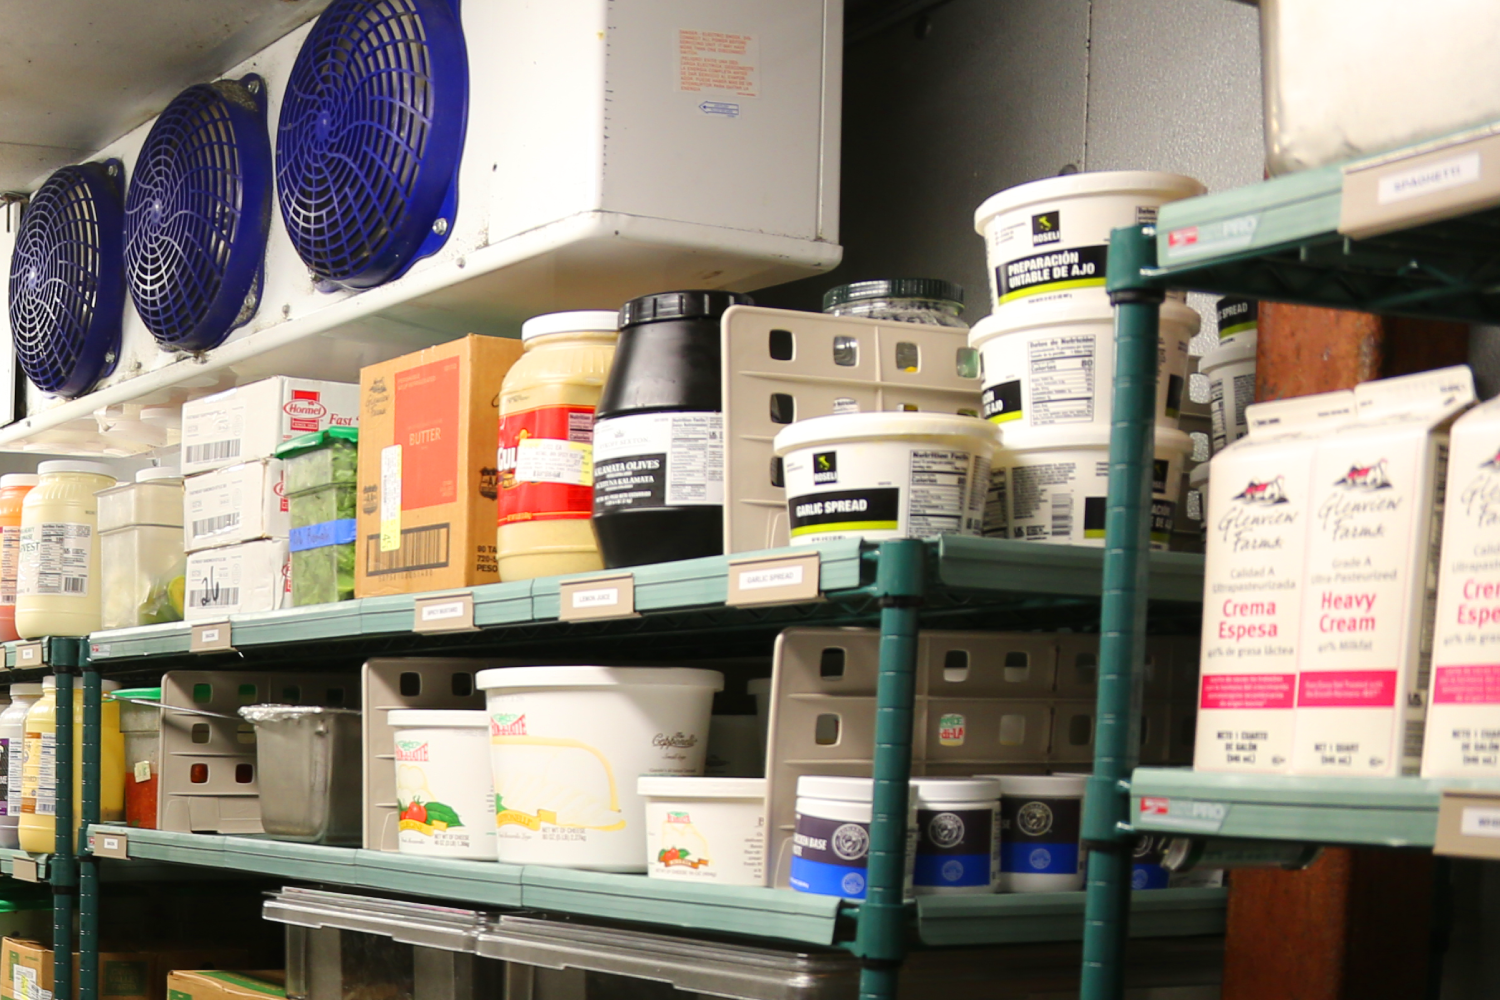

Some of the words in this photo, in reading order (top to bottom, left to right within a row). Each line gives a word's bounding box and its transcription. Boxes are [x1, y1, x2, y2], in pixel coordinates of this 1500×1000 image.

[1033, 231, 1060, 243] ROSELI
[1008, 251, 1079, 276] PREPARACIÓN
[1009, 270, 1050, 289] UNTABLE
[1052, 266, 1069, 279] DE
[1071, 262, 1095, 276] AJO
[1221, 303, 1248, 319] SPREAD
[289, 403, 322, 415] Hormel
[329, 413, 352, 426] Fast
[409, 427, 441, 446] BUTTER
[497, 447, 518, 472] GUL
[626, 459, 660, 470] OLIVES
[814, 472, 837, 482] ROSELI
[796, 502, 822, 518] GARLIC
[824, 499, 868, 514] SPREAD
[1318, 493, 1401, 530] Glenview
[1218, 507, 1297, 543] Glenview
[1333, 514, 1384, 541] Farms
[488, 545, 498, 553] TA
[1234, 528, 1282, 552] Farms
[1332, 558, 1360, 568] Grade
[1364, 557, 1372, 566] A
[771, 571, 794, 582] SPREAD
[1231, 567, 1265, 578] Calidad
[1268, 567, 1275, 575] A
[579, 594, 597, 603] LEMON
[1321, 591, 1376, 613] Heavy
[1223, 599, 1276, 617] Crema
[1457, 604, 1500, 629] Espe
[1219, 621, 1278, 642] Espesa
[1319, 614, 1376, 633] Cream
[810, 837, 827, 850] BASE
